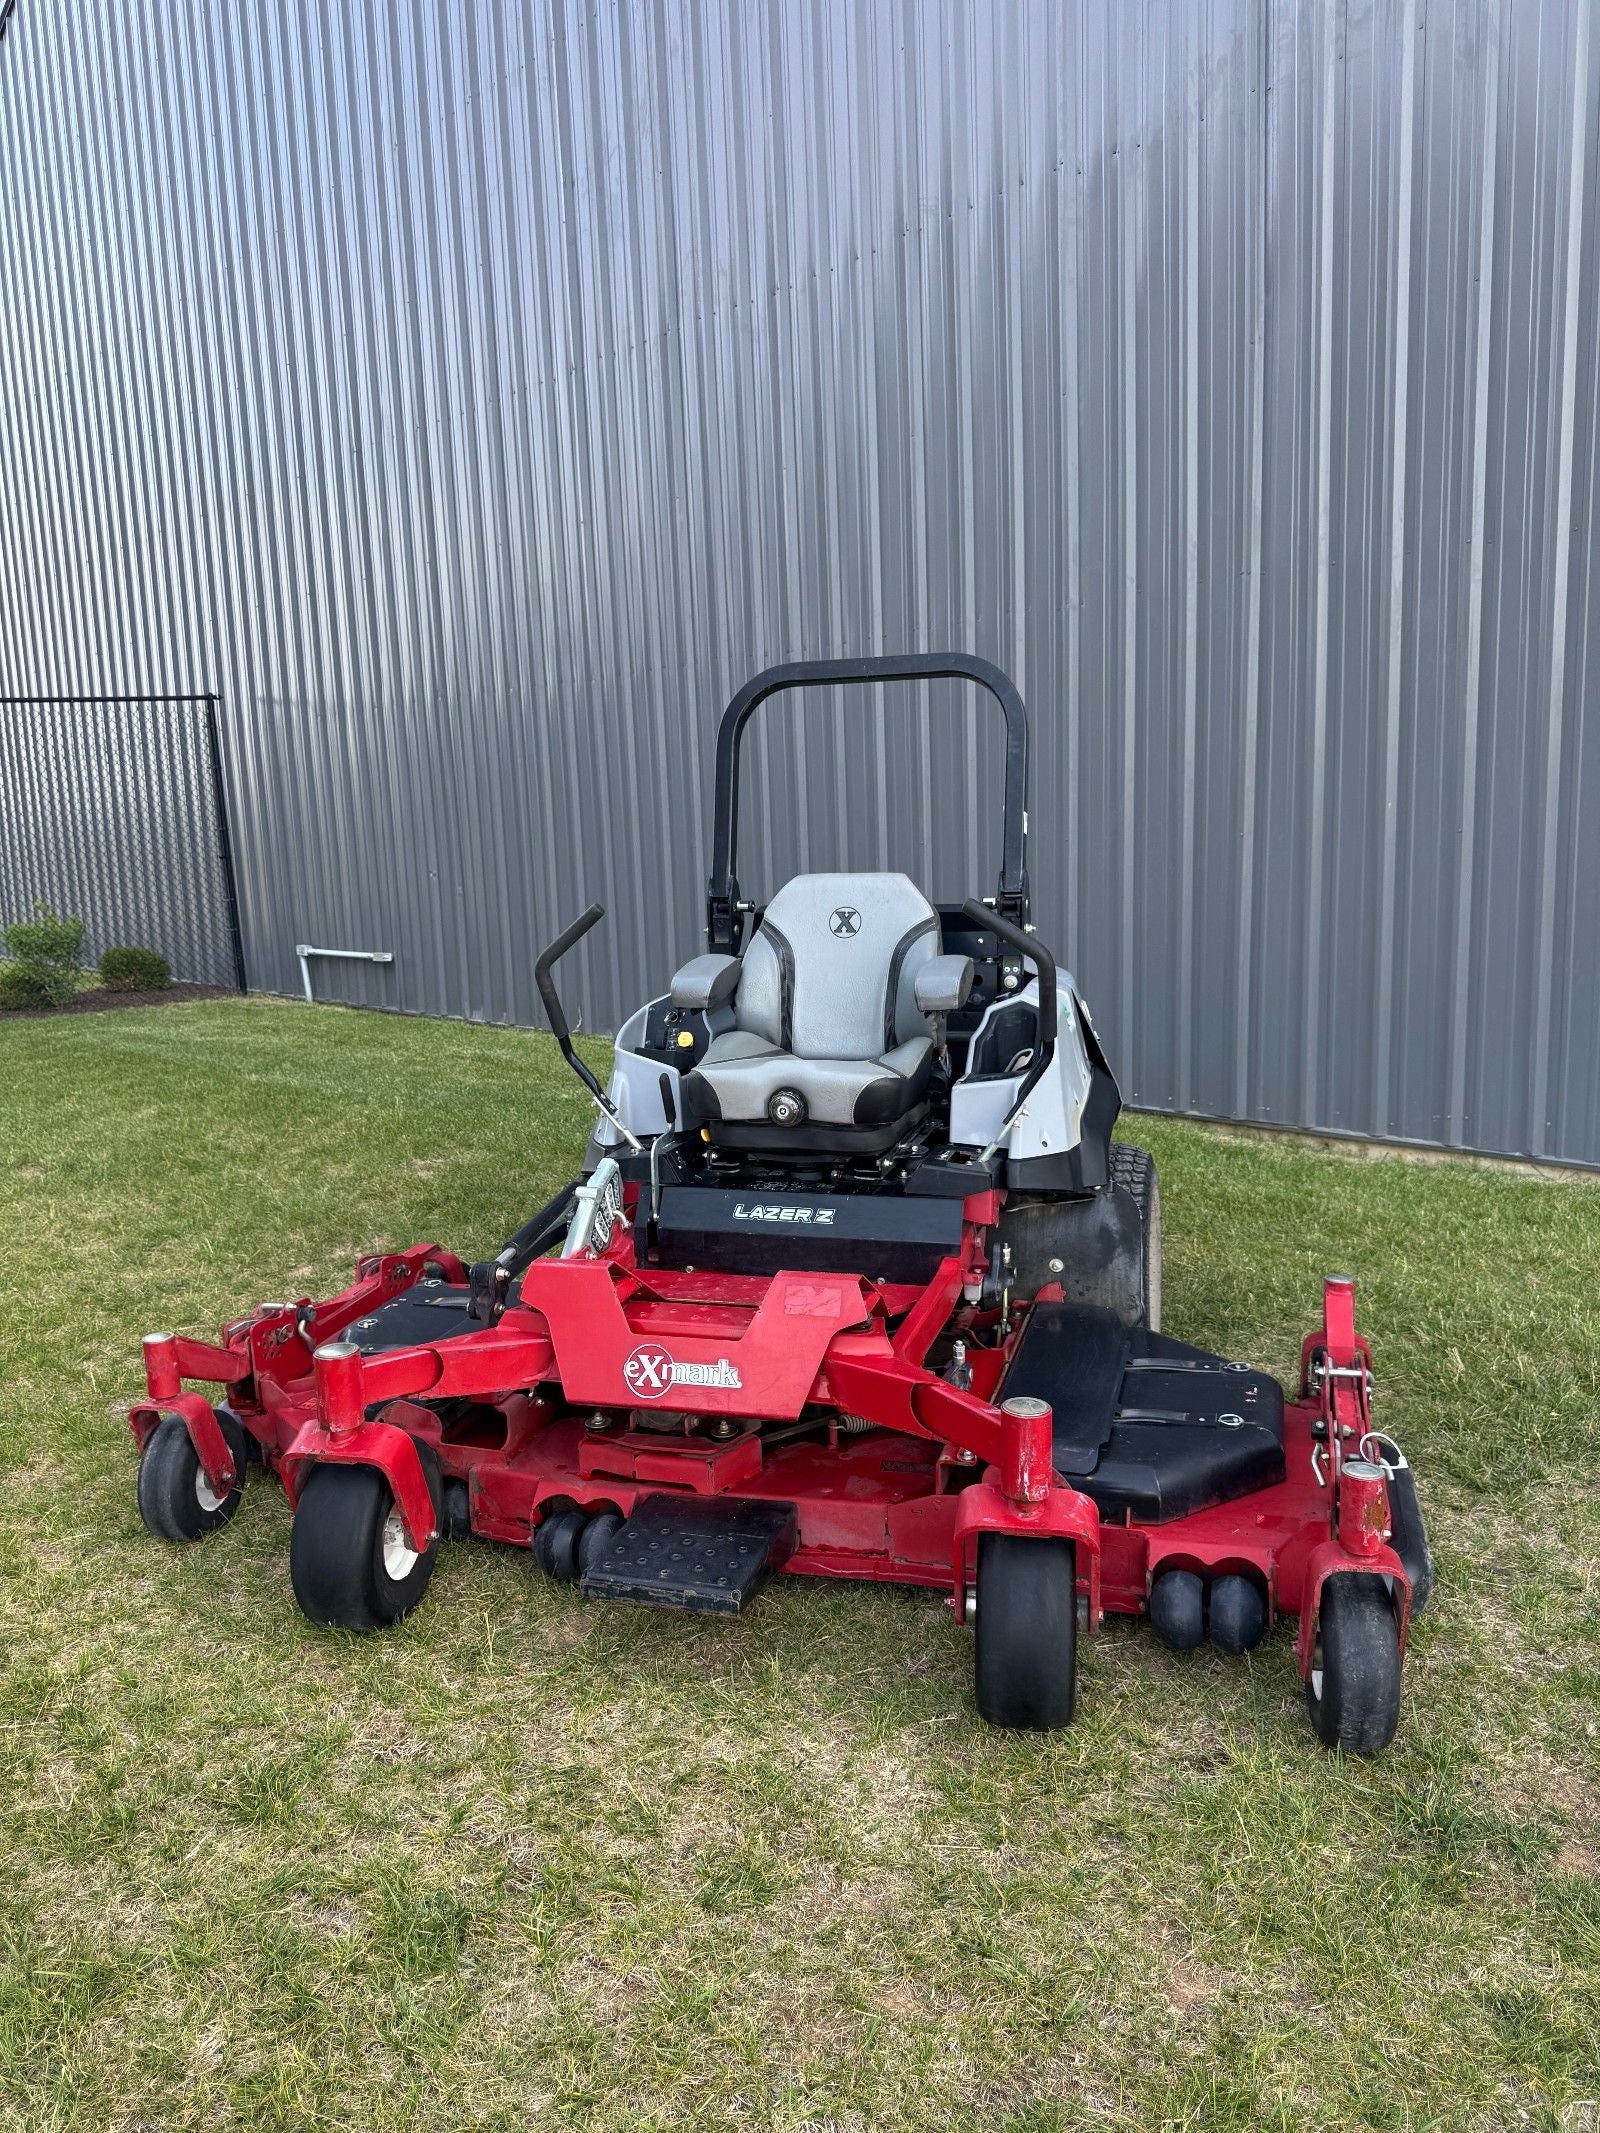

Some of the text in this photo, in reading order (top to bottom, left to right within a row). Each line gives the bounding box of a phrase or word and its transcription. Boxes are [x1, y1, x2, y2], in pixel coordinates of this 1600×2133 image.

[832, 910, 858, 934] X
[733, 1203, 836, 1225] LAZER Z
